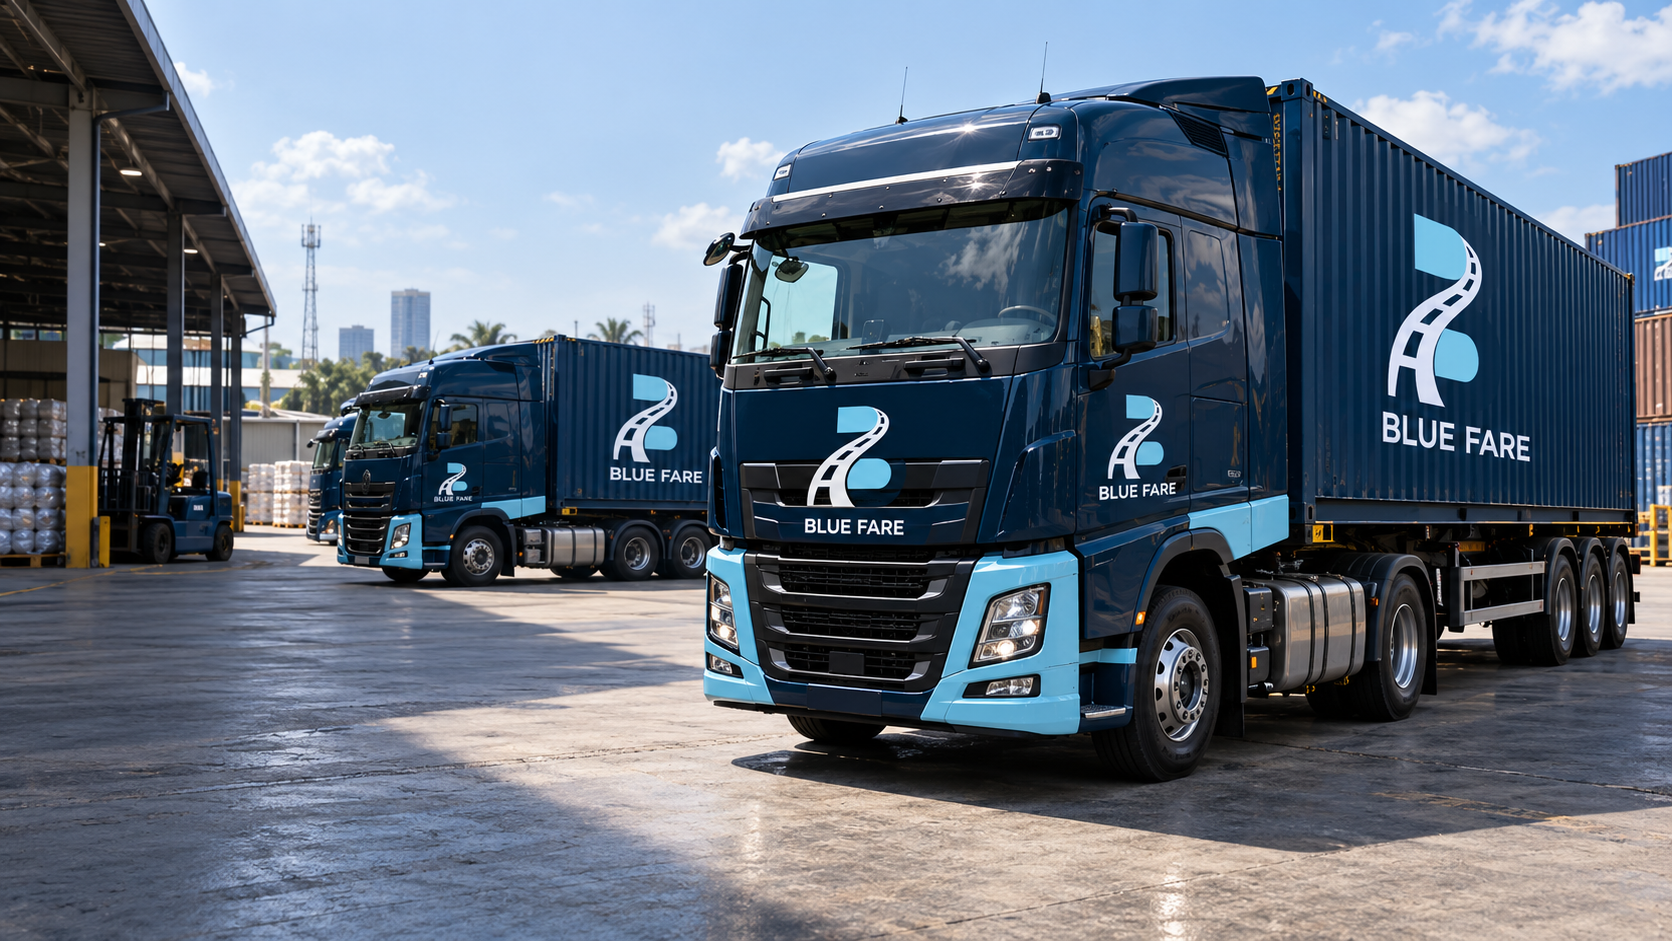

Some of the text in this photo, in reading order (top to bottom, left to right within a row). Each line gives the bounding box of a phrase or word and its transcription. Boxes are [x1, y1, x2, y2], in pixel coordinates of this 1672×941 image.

[1382, 411, 1531, 462] BLUE FARE
[609, 466, 703, 484] BLUE FARE
[1099, 482, 1177, 501] BLUE FARE
[804, 518, 905, 536] BLUE FARE
